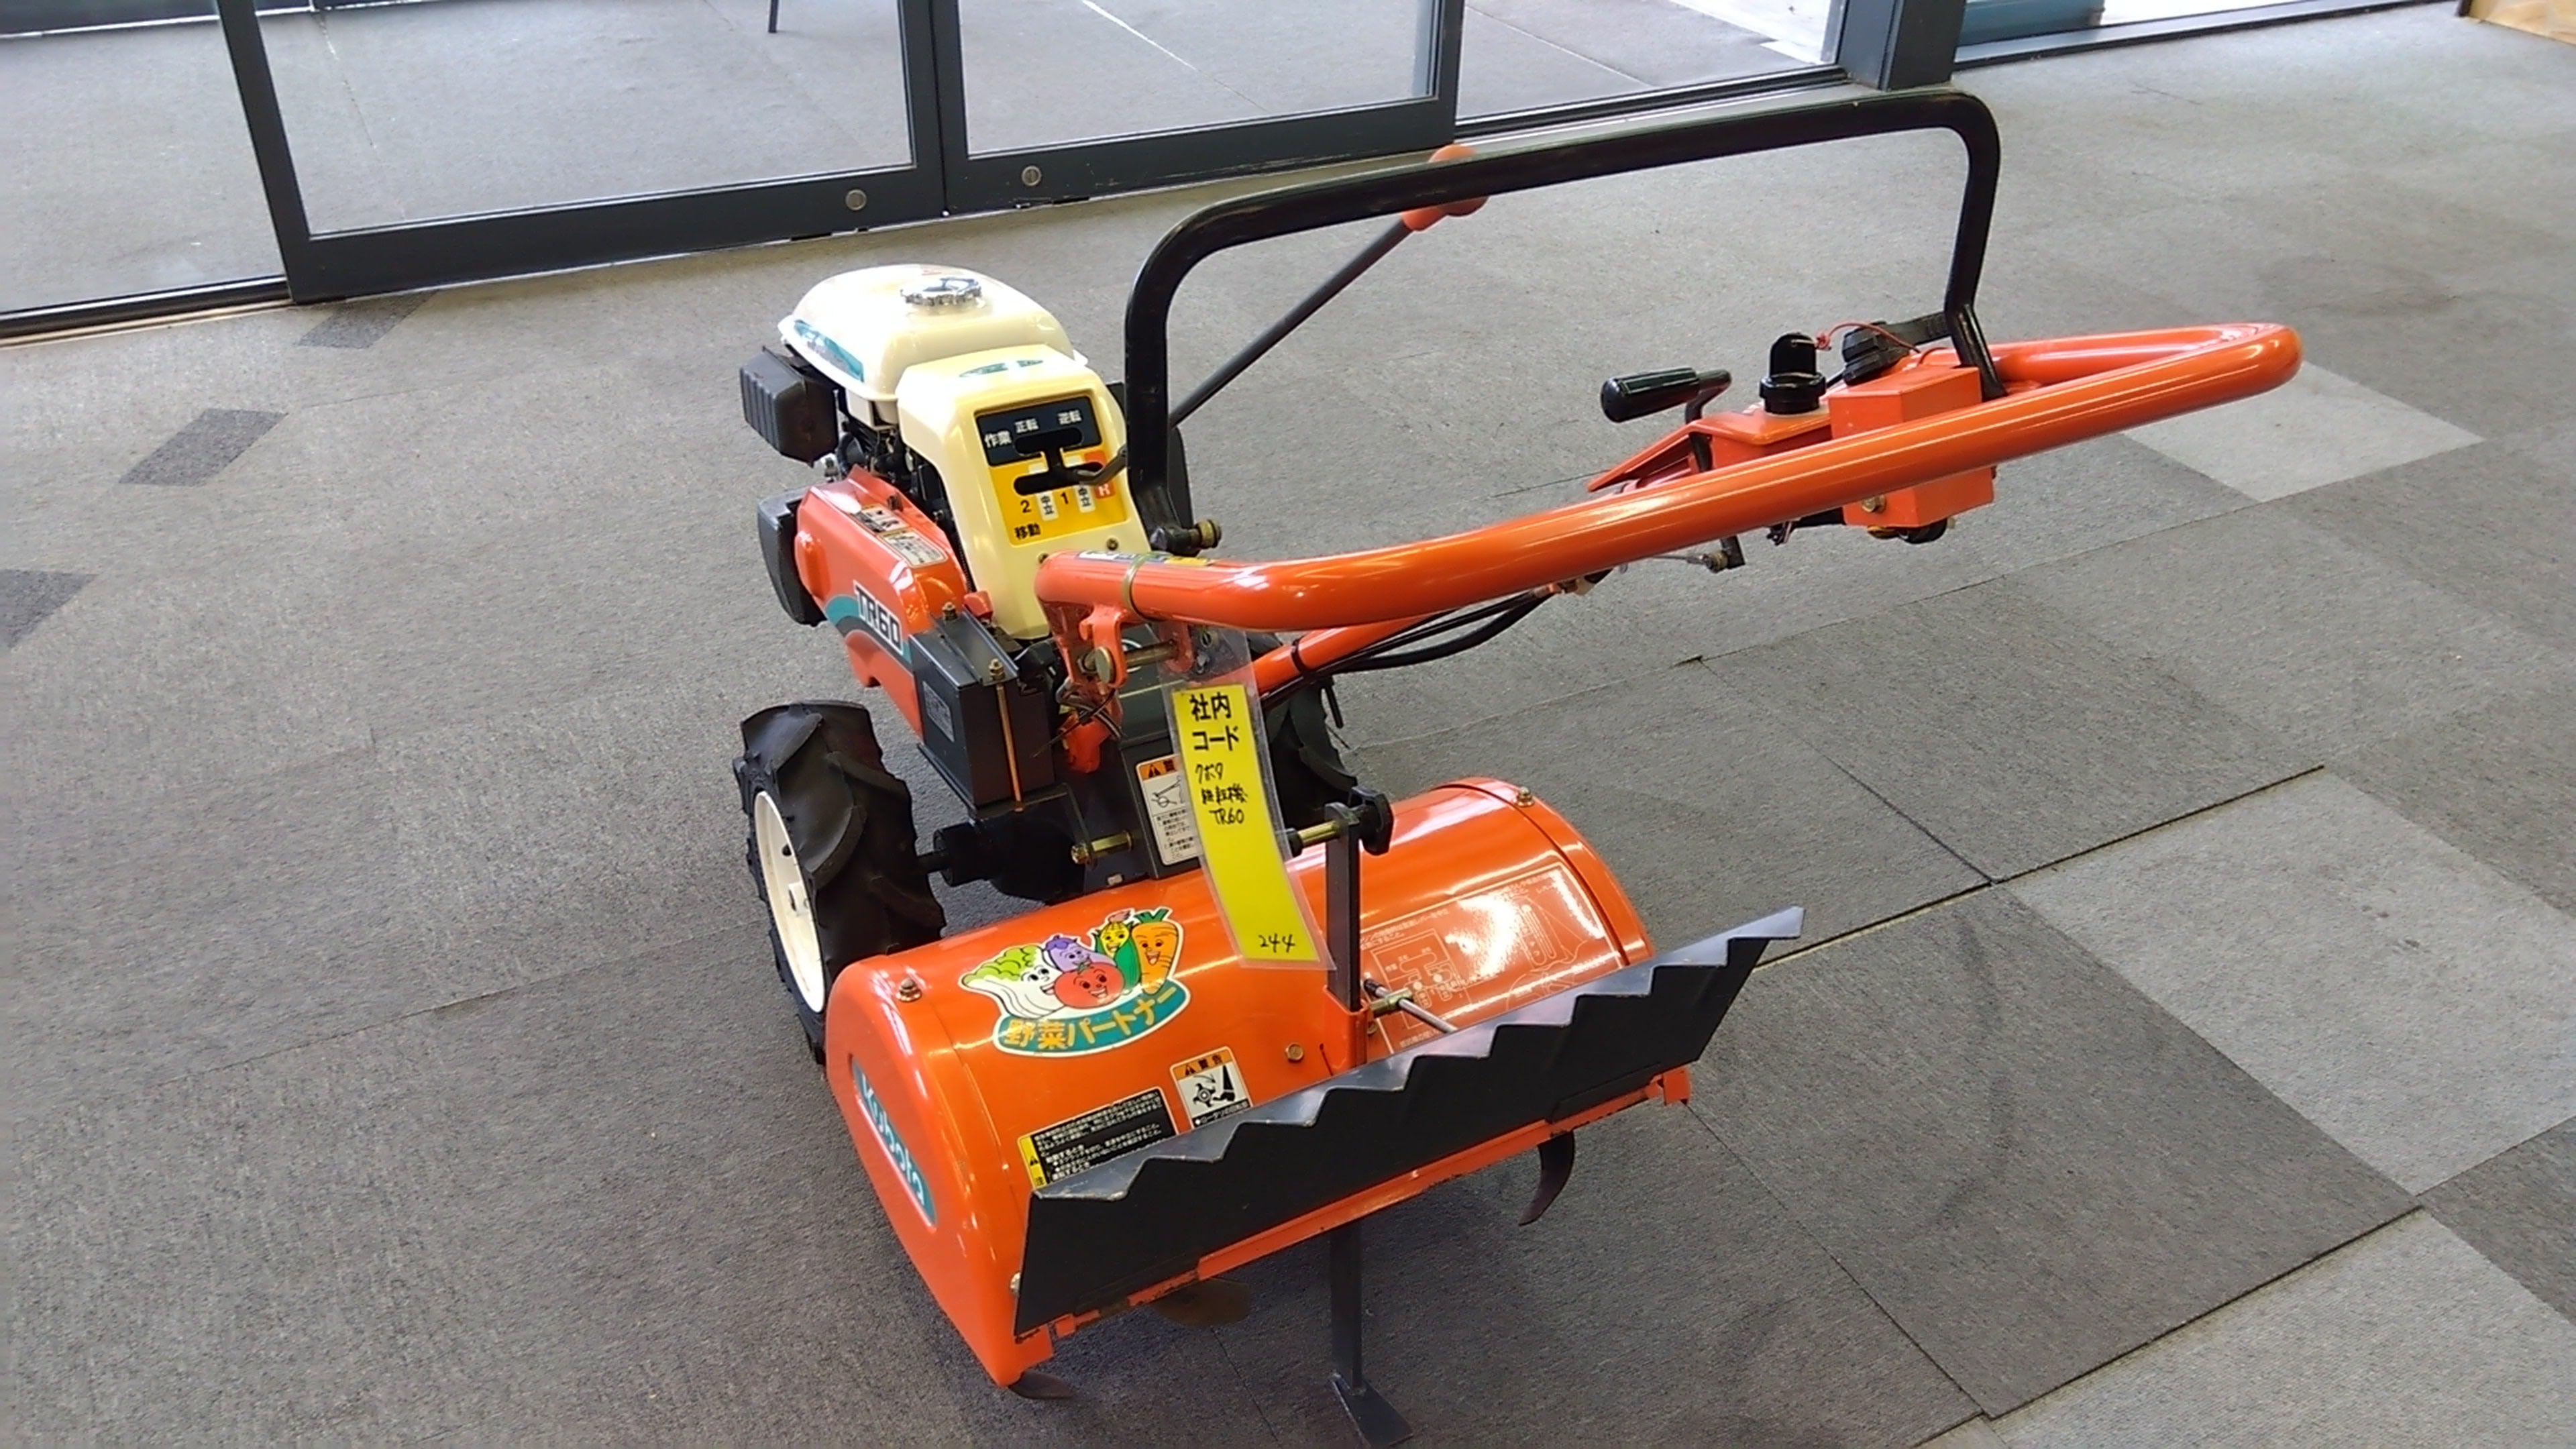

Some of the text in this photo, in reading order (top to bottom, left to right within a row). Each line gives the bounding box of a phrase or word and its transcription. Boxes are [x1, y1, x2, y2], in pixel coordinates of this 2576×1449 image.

[984, 430, 1012, 448] 作業
[1020, 500, 1032, 513] 2
[1040, 496, 1055, 515] 中立
[1061, 492, 1069, 504] 1
[1098, 484, 1111, 497] R
[1014, 523, 1041, 540] 移動
[854, 582, 903, 653] TR60
[1190, 692, 1231, 721] 社内
[1193, 725, 1238, 751] コード
[1209, 808, 1244, 825] TR60
[1258, 932, 1295, 953] 244
[1004, 986, 1177, 1047] 野菜パートナー
[861, 1073, 924, 1205] Kubota
